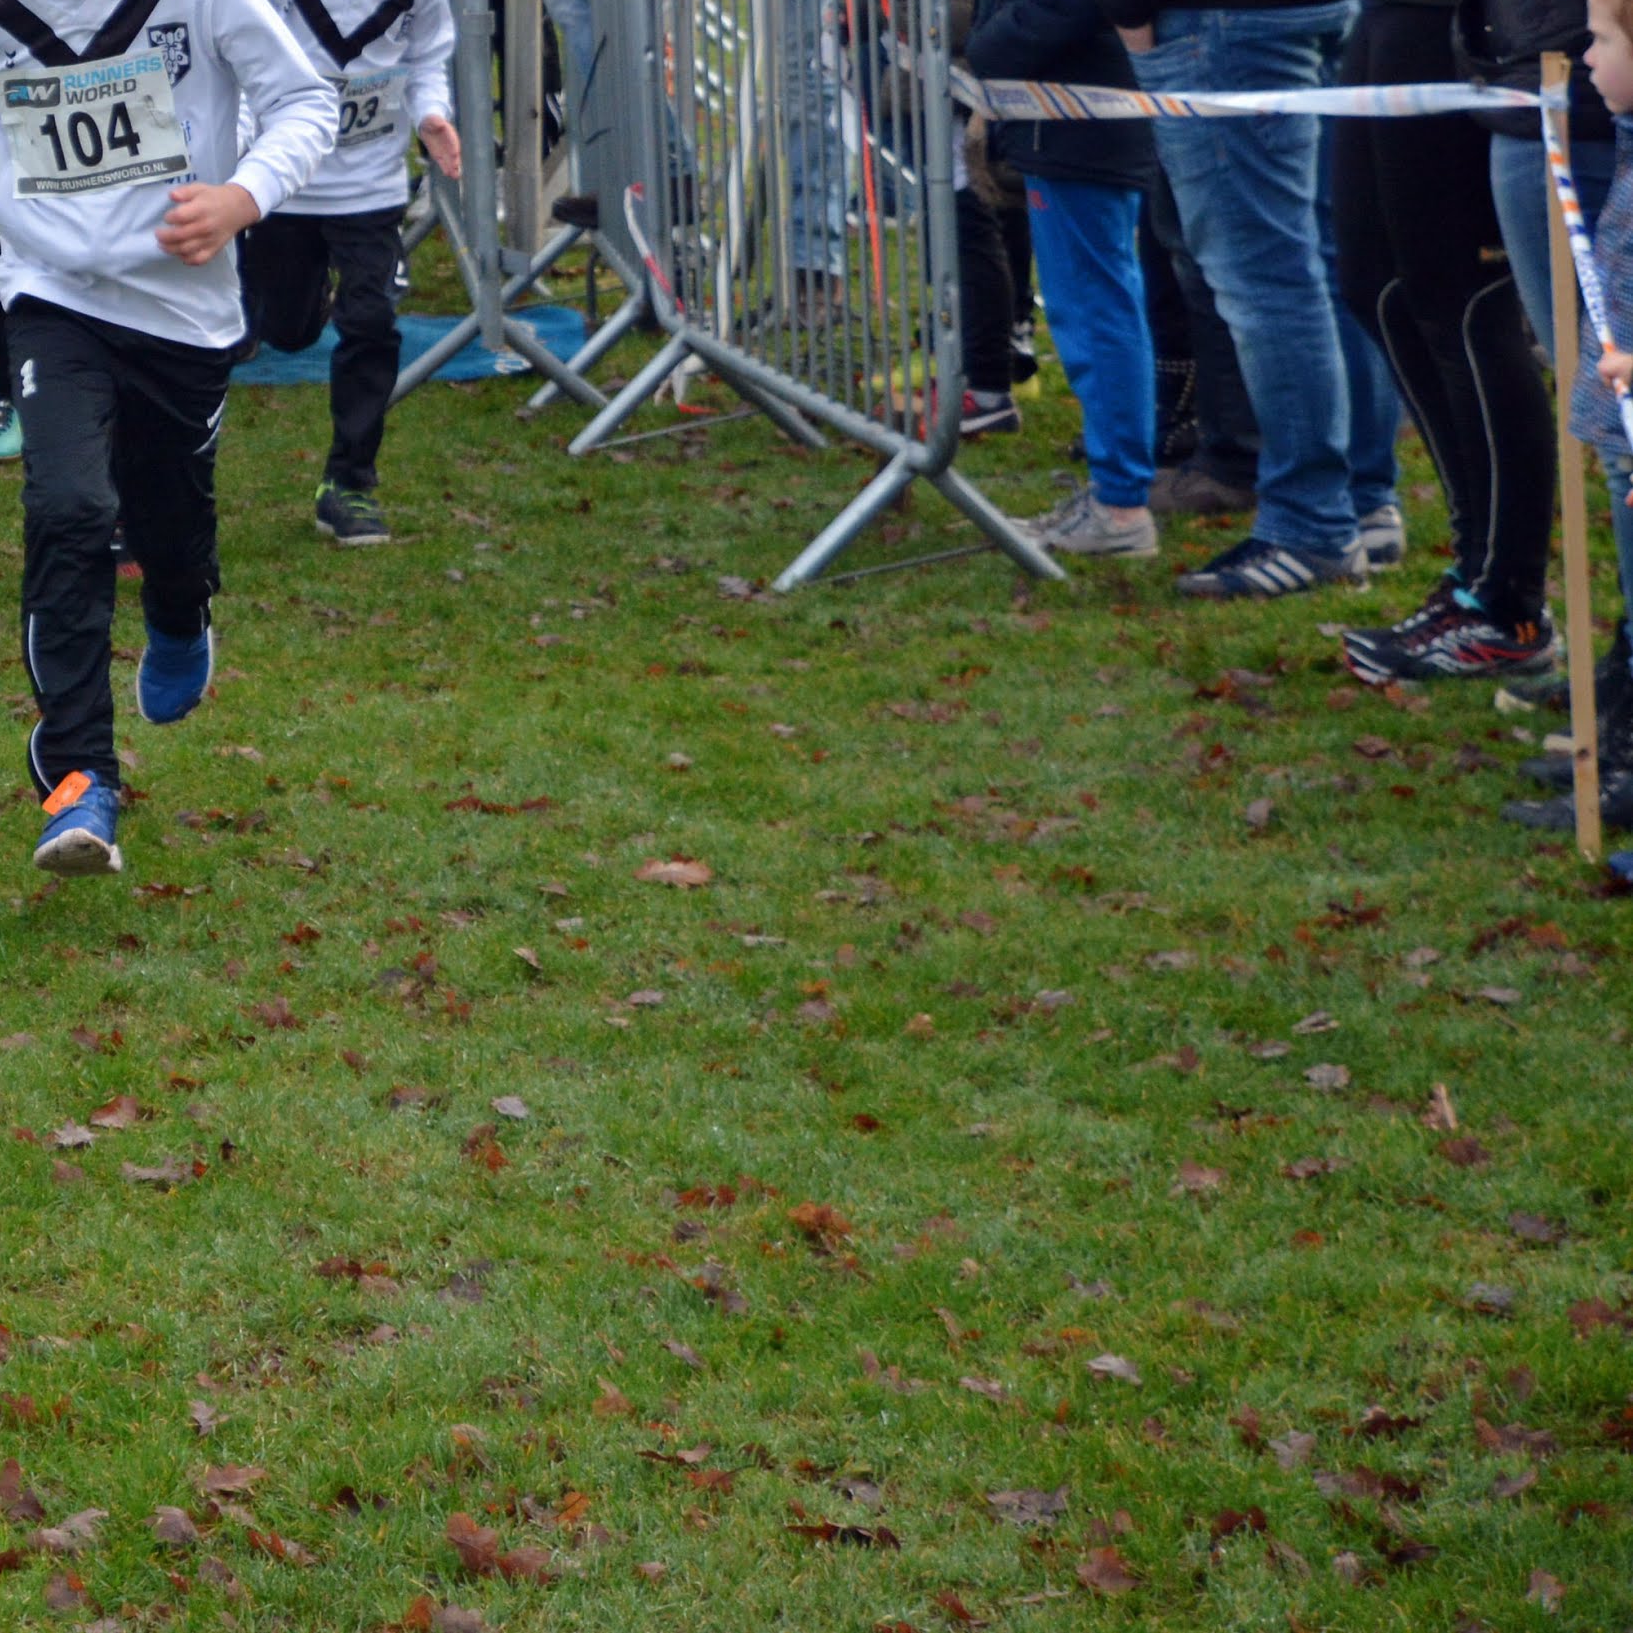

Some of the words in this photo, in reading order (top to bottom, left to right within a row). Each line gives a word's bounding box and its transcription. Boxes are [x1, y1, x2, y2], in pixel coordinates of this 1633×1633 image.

[63, 56, 163, 91] RUNNERS
[65, 78, 137, 105] WORLD
[39, 101, 141, 171] 104
[36, 162, 168, 190] WWW.RUNNERSWORLD.NL
